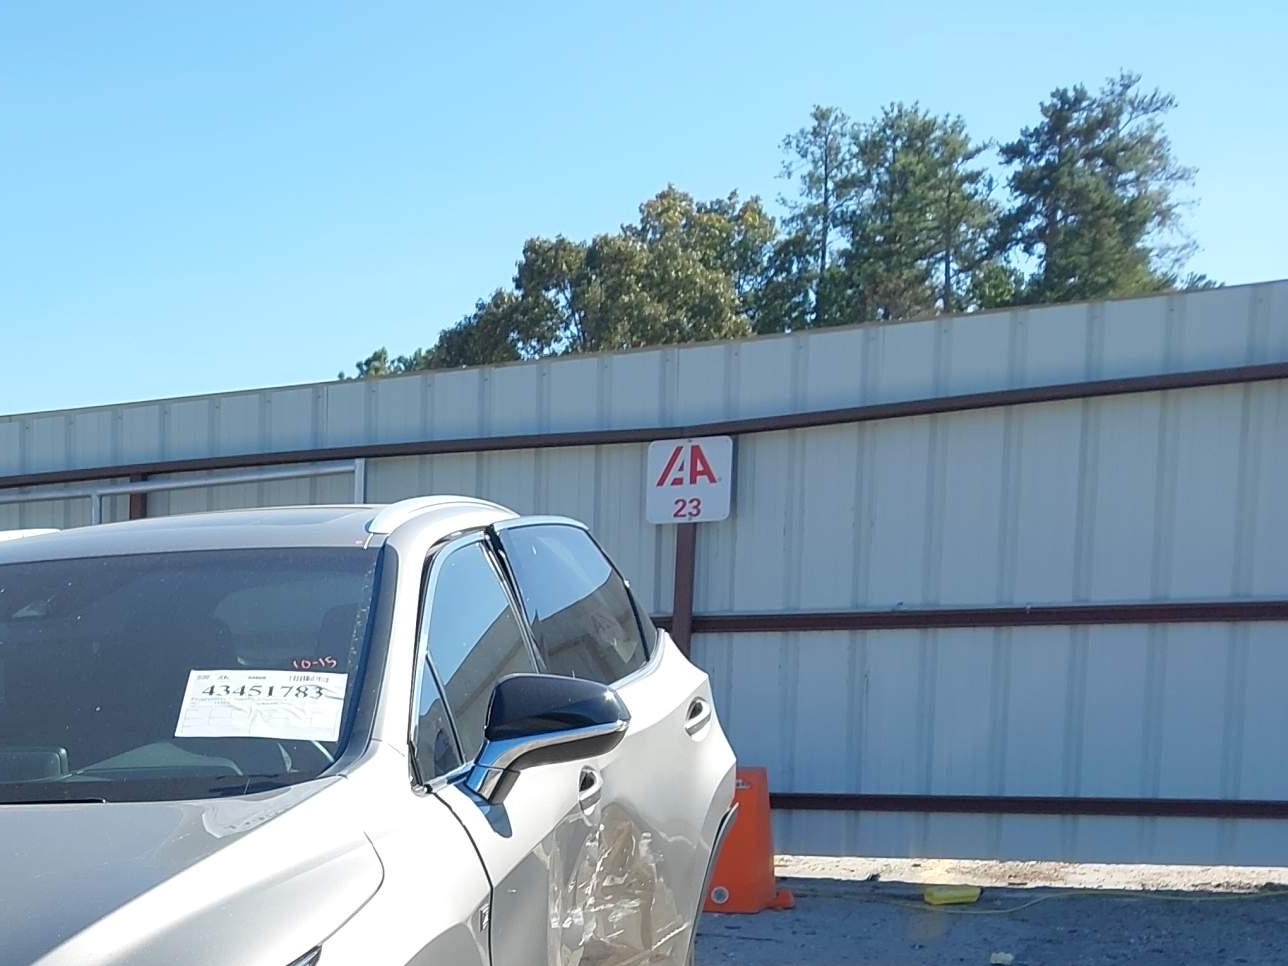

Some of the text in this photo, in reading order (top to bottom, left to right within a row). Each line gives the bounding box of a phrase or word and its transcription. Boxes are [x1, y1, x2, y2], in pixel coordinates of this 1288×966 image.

[673, 498, 701, 518] 23
[293, 655, 337, 669] 10-15
[202, 684, 324, 699] 43451783
